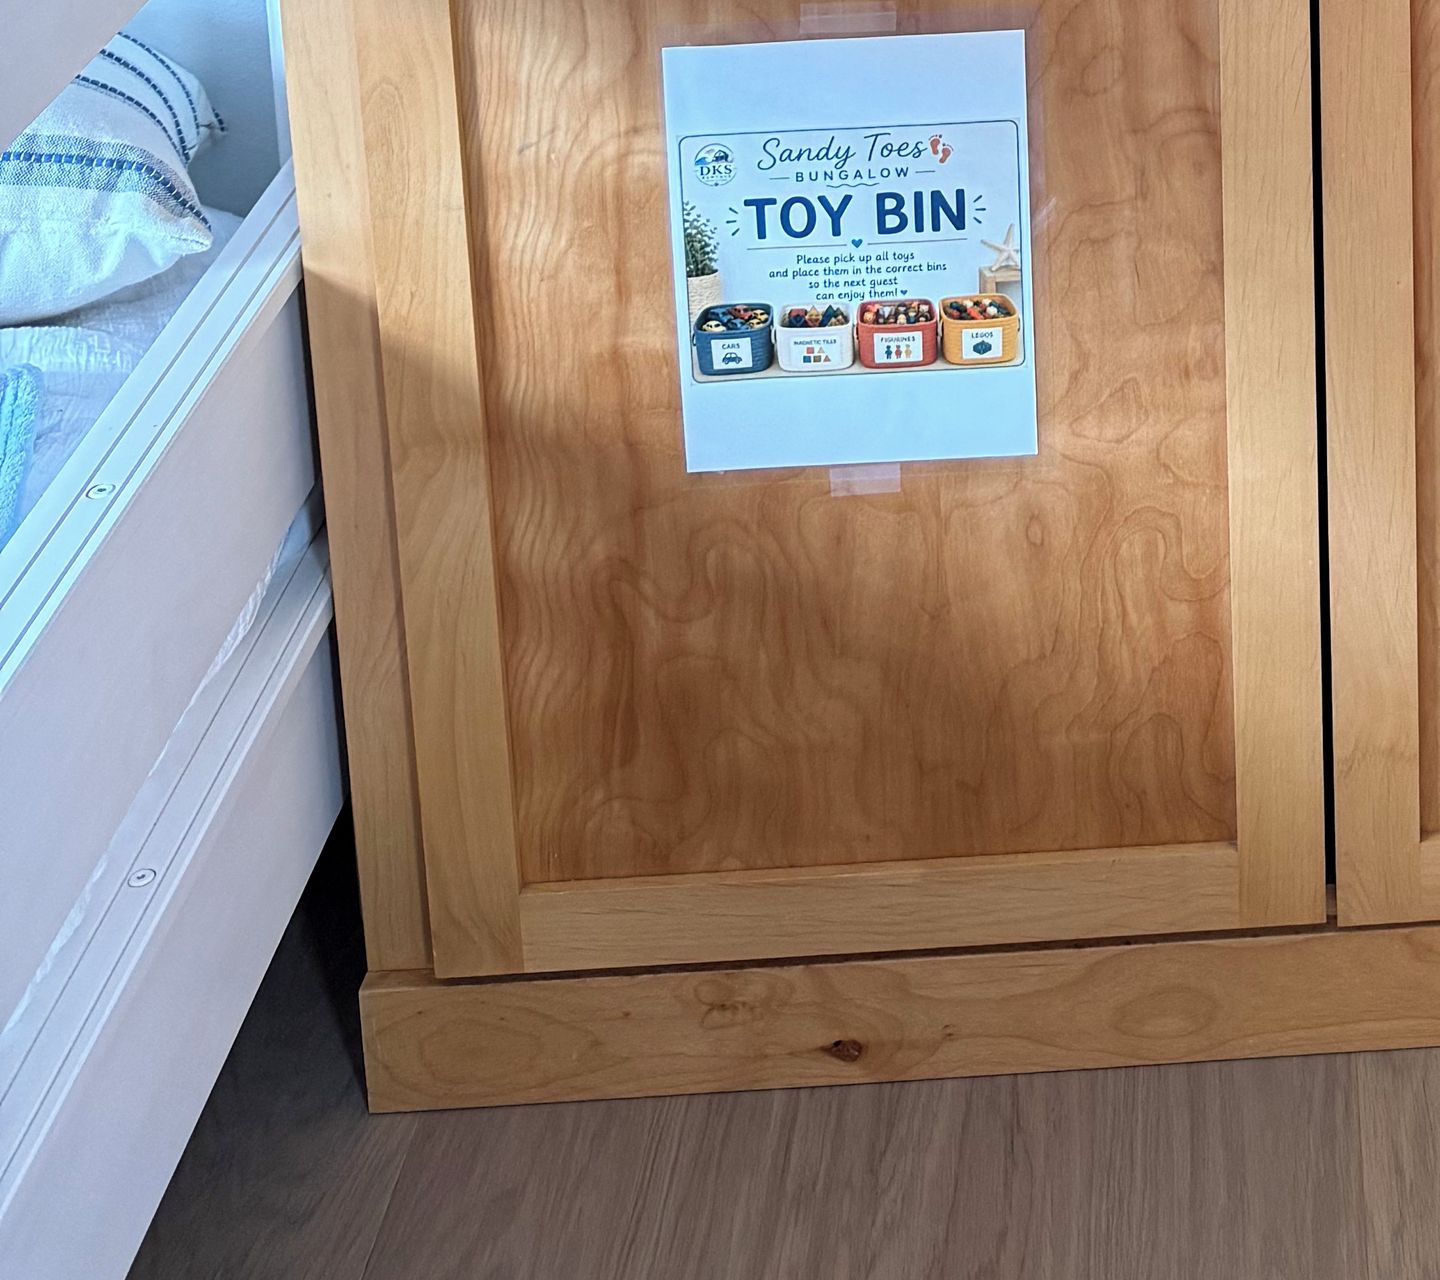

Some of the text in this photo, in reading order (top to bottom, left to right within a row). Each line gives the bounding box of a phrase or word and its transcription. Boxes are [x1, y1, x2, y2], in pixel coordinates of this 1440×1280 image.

[757, 132, 928, 170] Sandy Toes
[700, 165, 733, 176] DKS
[795, 167, 909, 182] BUNGALOW
[743, 188, 966, 240] TOY BIN
[796, 251, 915, 266] Please pick up all toys
[769, 262, 947, 280] and place them in the correct bins
[808, 277, 899, 290] so the next guest
[815, 289, 898, 302] can enjoy them!
[971, 331, 994, 339] LEGOS
